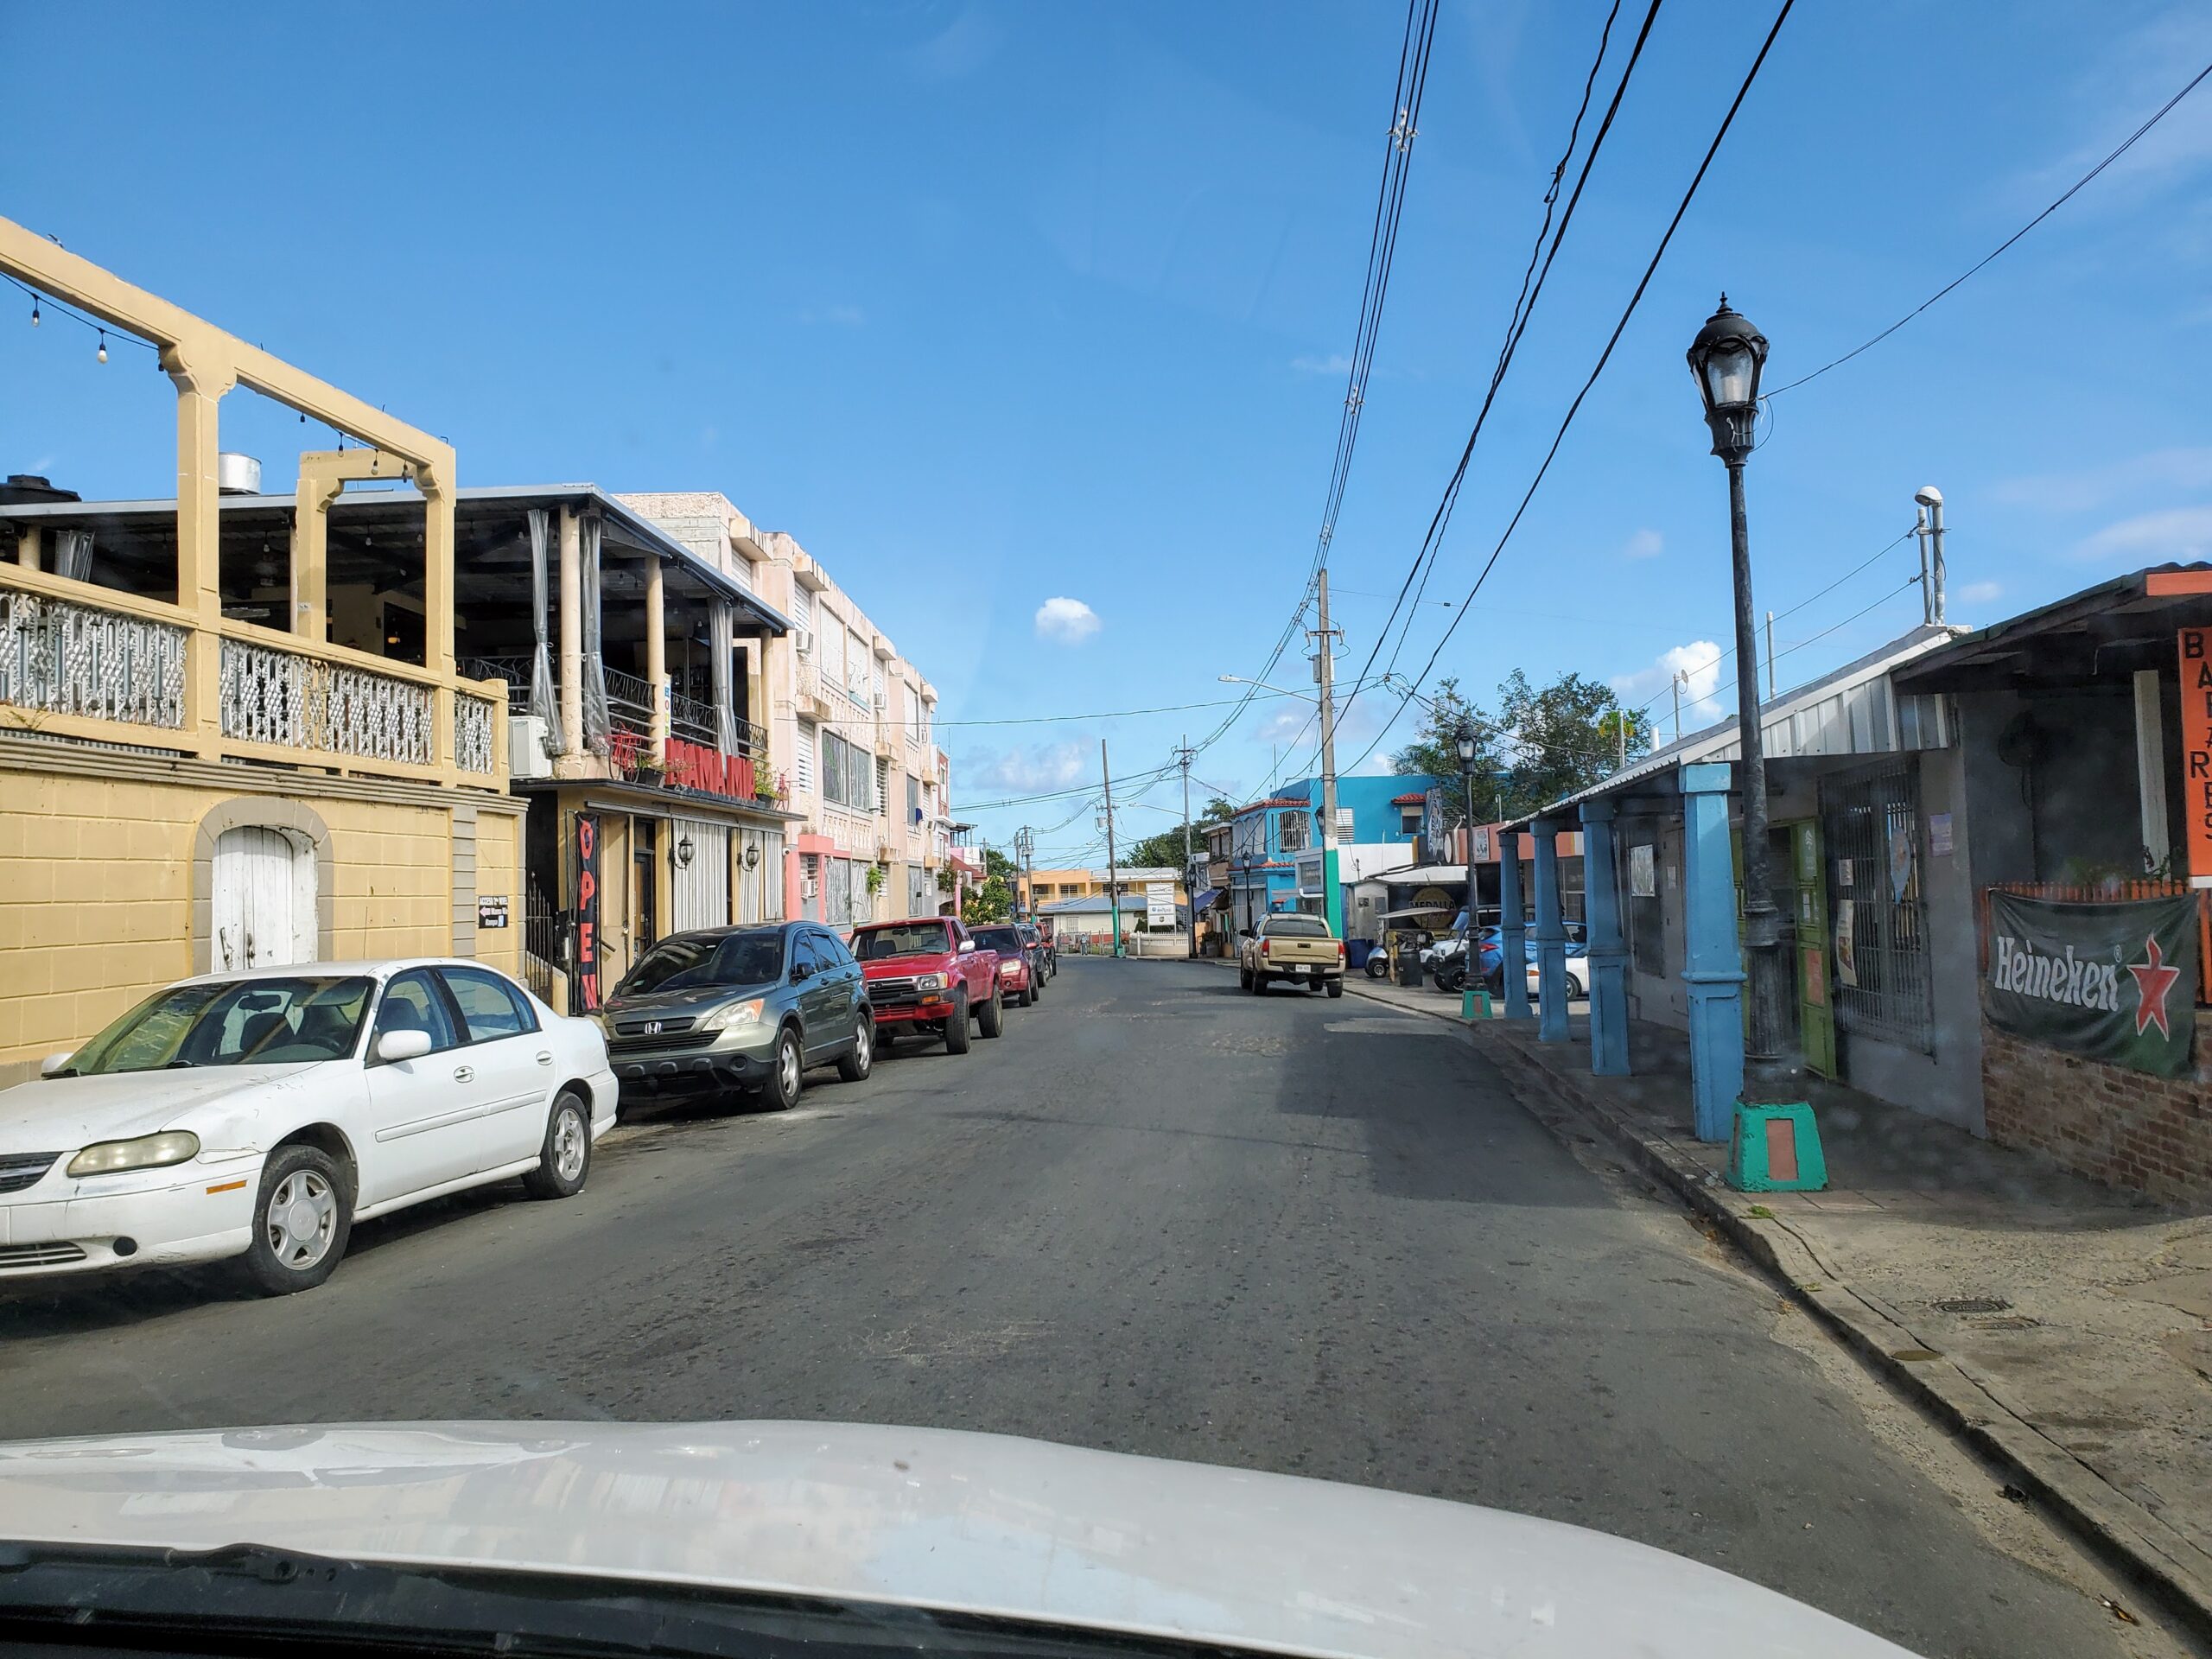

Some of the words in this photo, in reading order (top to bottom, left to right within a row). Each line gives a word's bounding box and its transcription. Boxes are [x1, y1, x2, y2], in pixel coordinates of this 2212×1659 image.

[664, 737, 728, 794] MAMA
[726, 754, 758, 802] MIA
[580, 820, 598, 1009] OPEN
[1995, 936, 2119, 1012] Heineken
